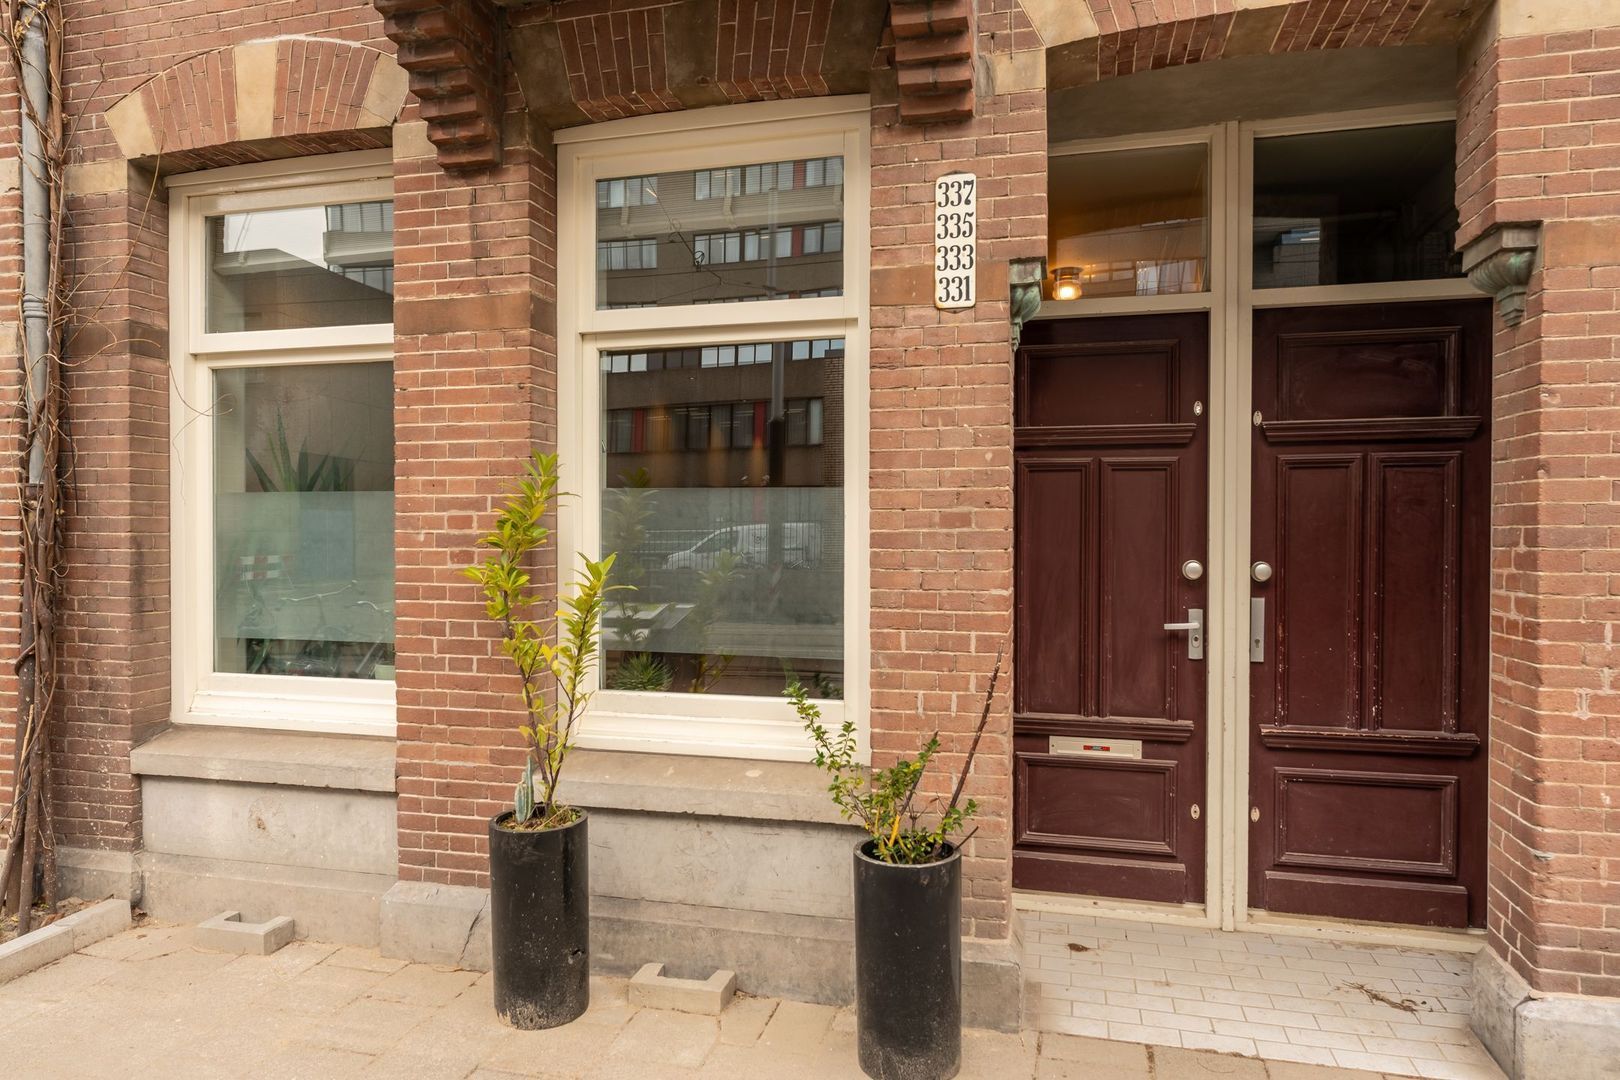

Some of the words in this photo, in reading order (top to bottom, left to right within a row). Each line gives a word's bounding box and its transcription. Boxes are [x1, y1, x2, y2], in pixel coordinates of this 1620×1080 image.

[938, 180, 974, 207] 337
[937, 212, 974, 239] 335
[937, 244, 974, 271] 333
[938, 275, 971, 302] 331
